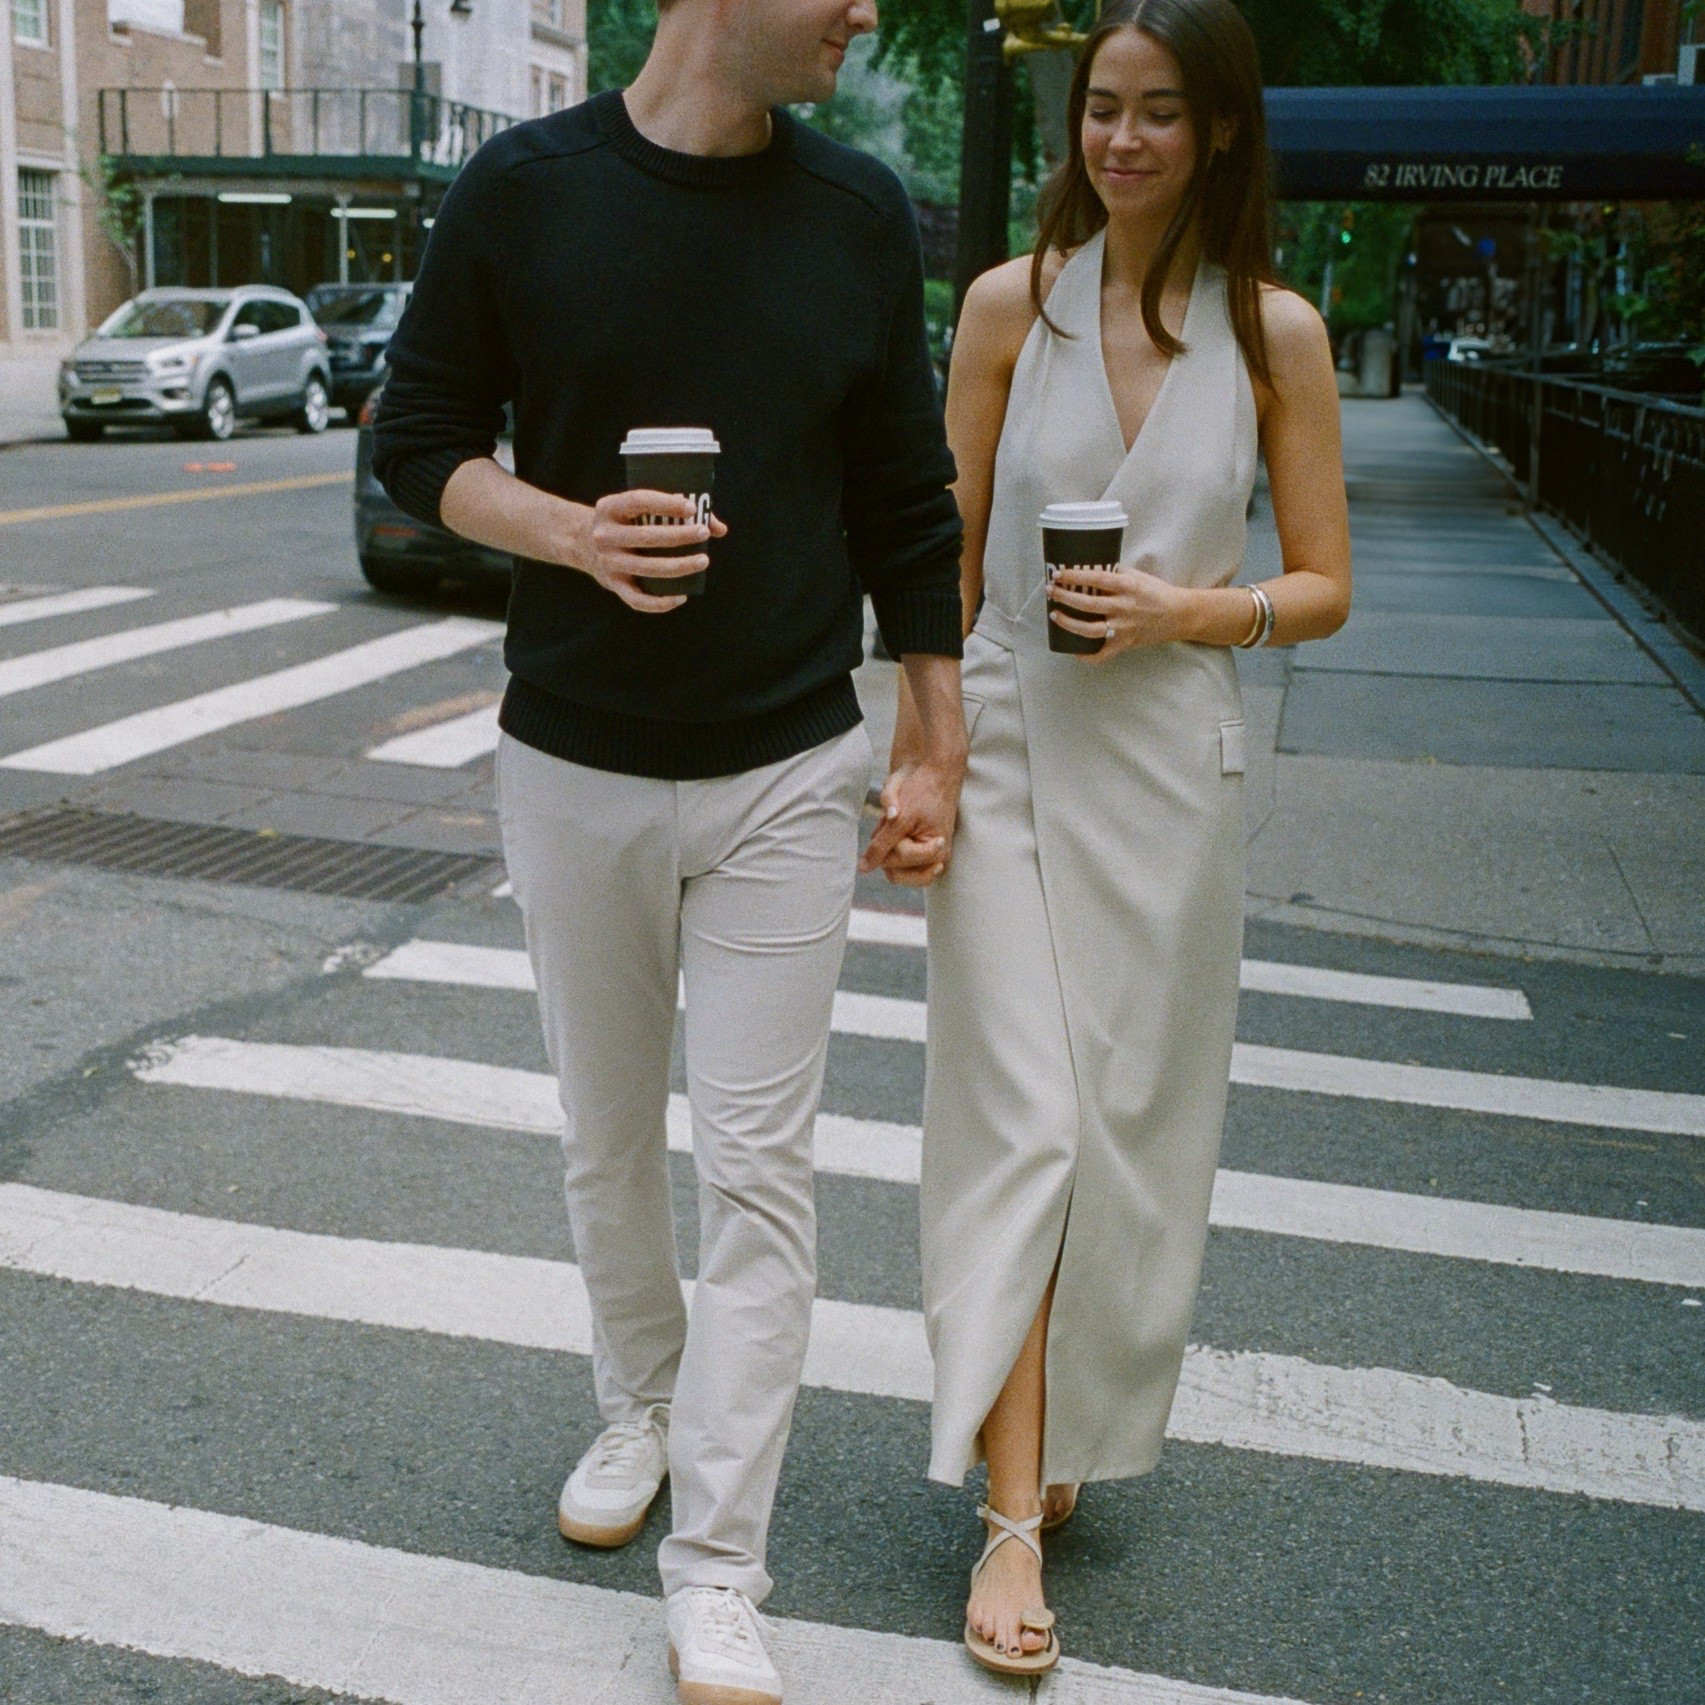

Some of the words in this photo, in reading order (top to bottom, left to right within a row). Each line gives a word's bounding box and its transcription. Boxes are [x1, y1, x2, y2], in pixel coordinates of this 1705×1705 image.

[1364, 163, 1390, 188] 82
[1395, 163, 1479, 188] IRVING
[1484, 164, 1564, 188] PLACE
